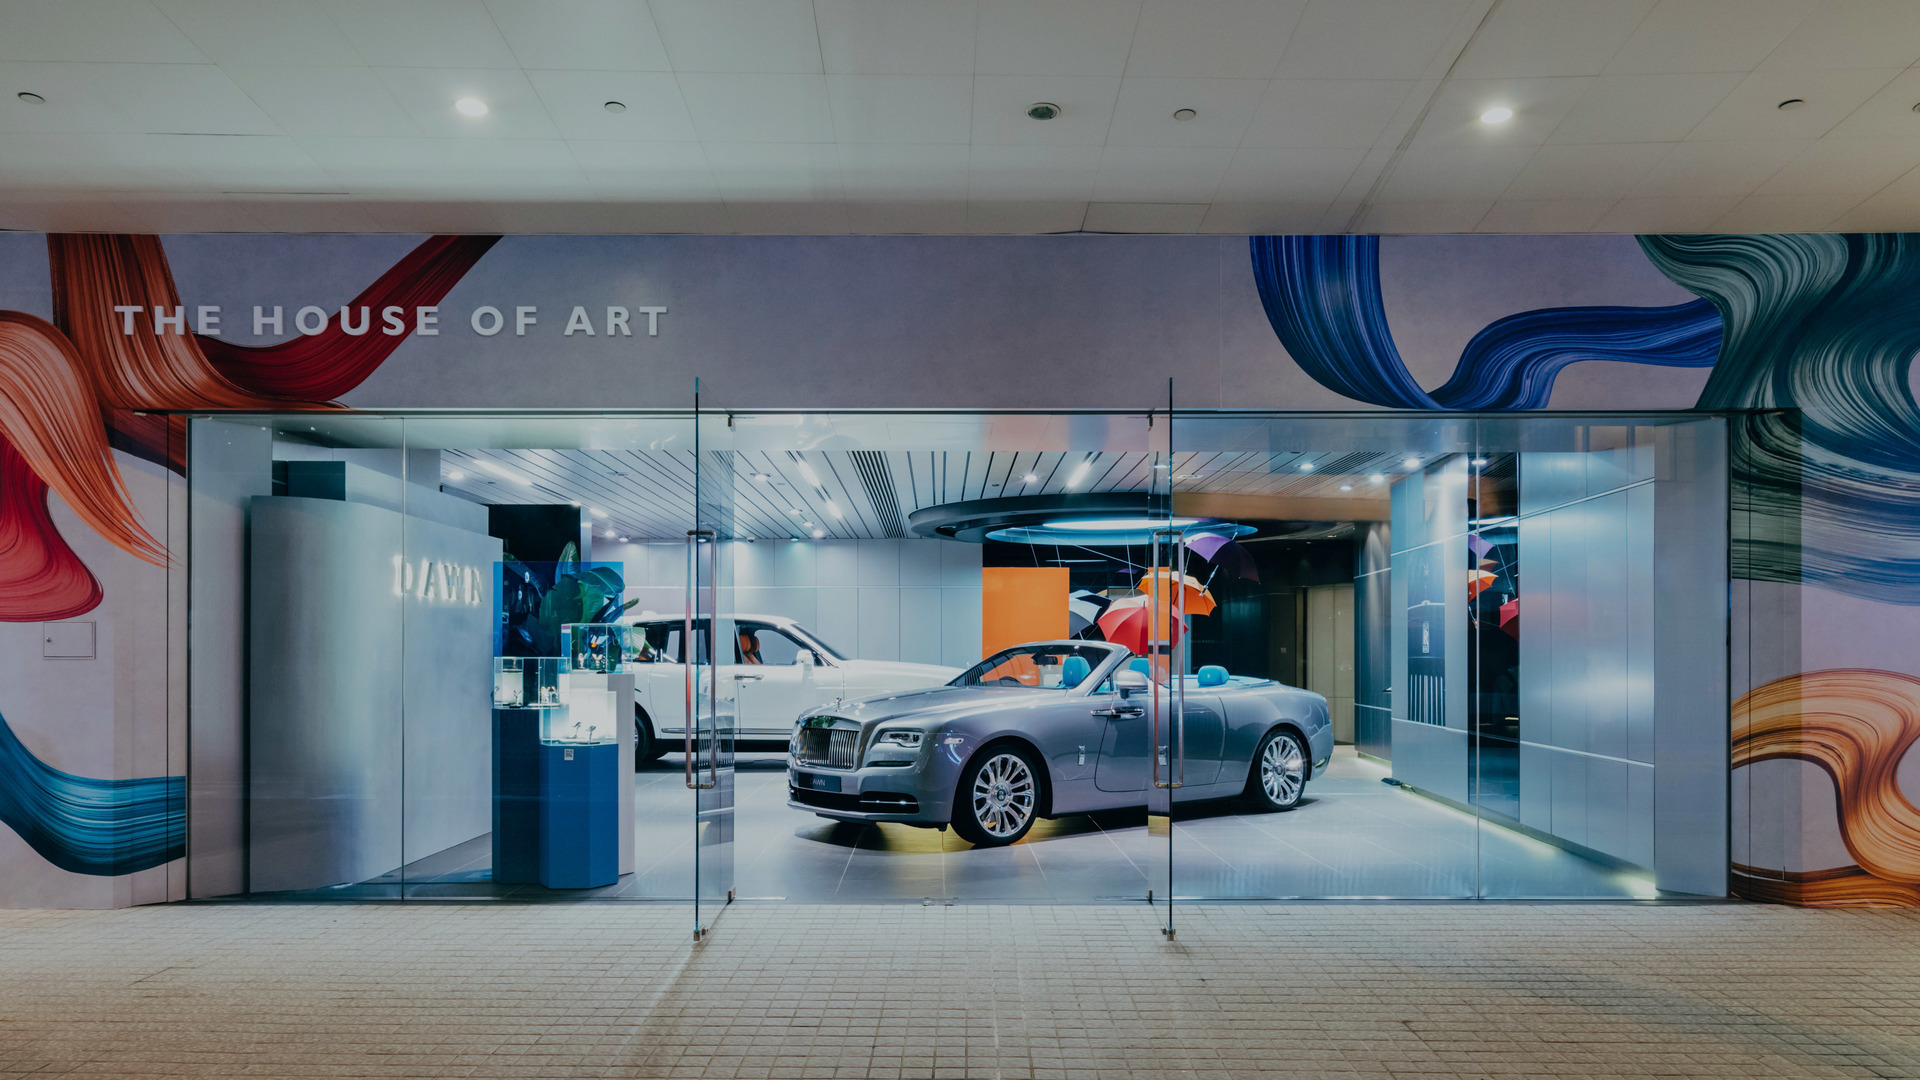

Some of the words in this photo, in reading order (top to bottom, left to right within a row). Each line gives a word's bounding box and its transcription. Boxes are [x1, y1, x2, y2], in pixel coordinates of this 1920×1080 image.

[114, 305, 221, 336] THE
[253, 305, 440, 336] HOUSE
[470, 305, 538, 337] OF
[563, 305, 668, 337] ART
[394, 556, 483, 604] DAWN
